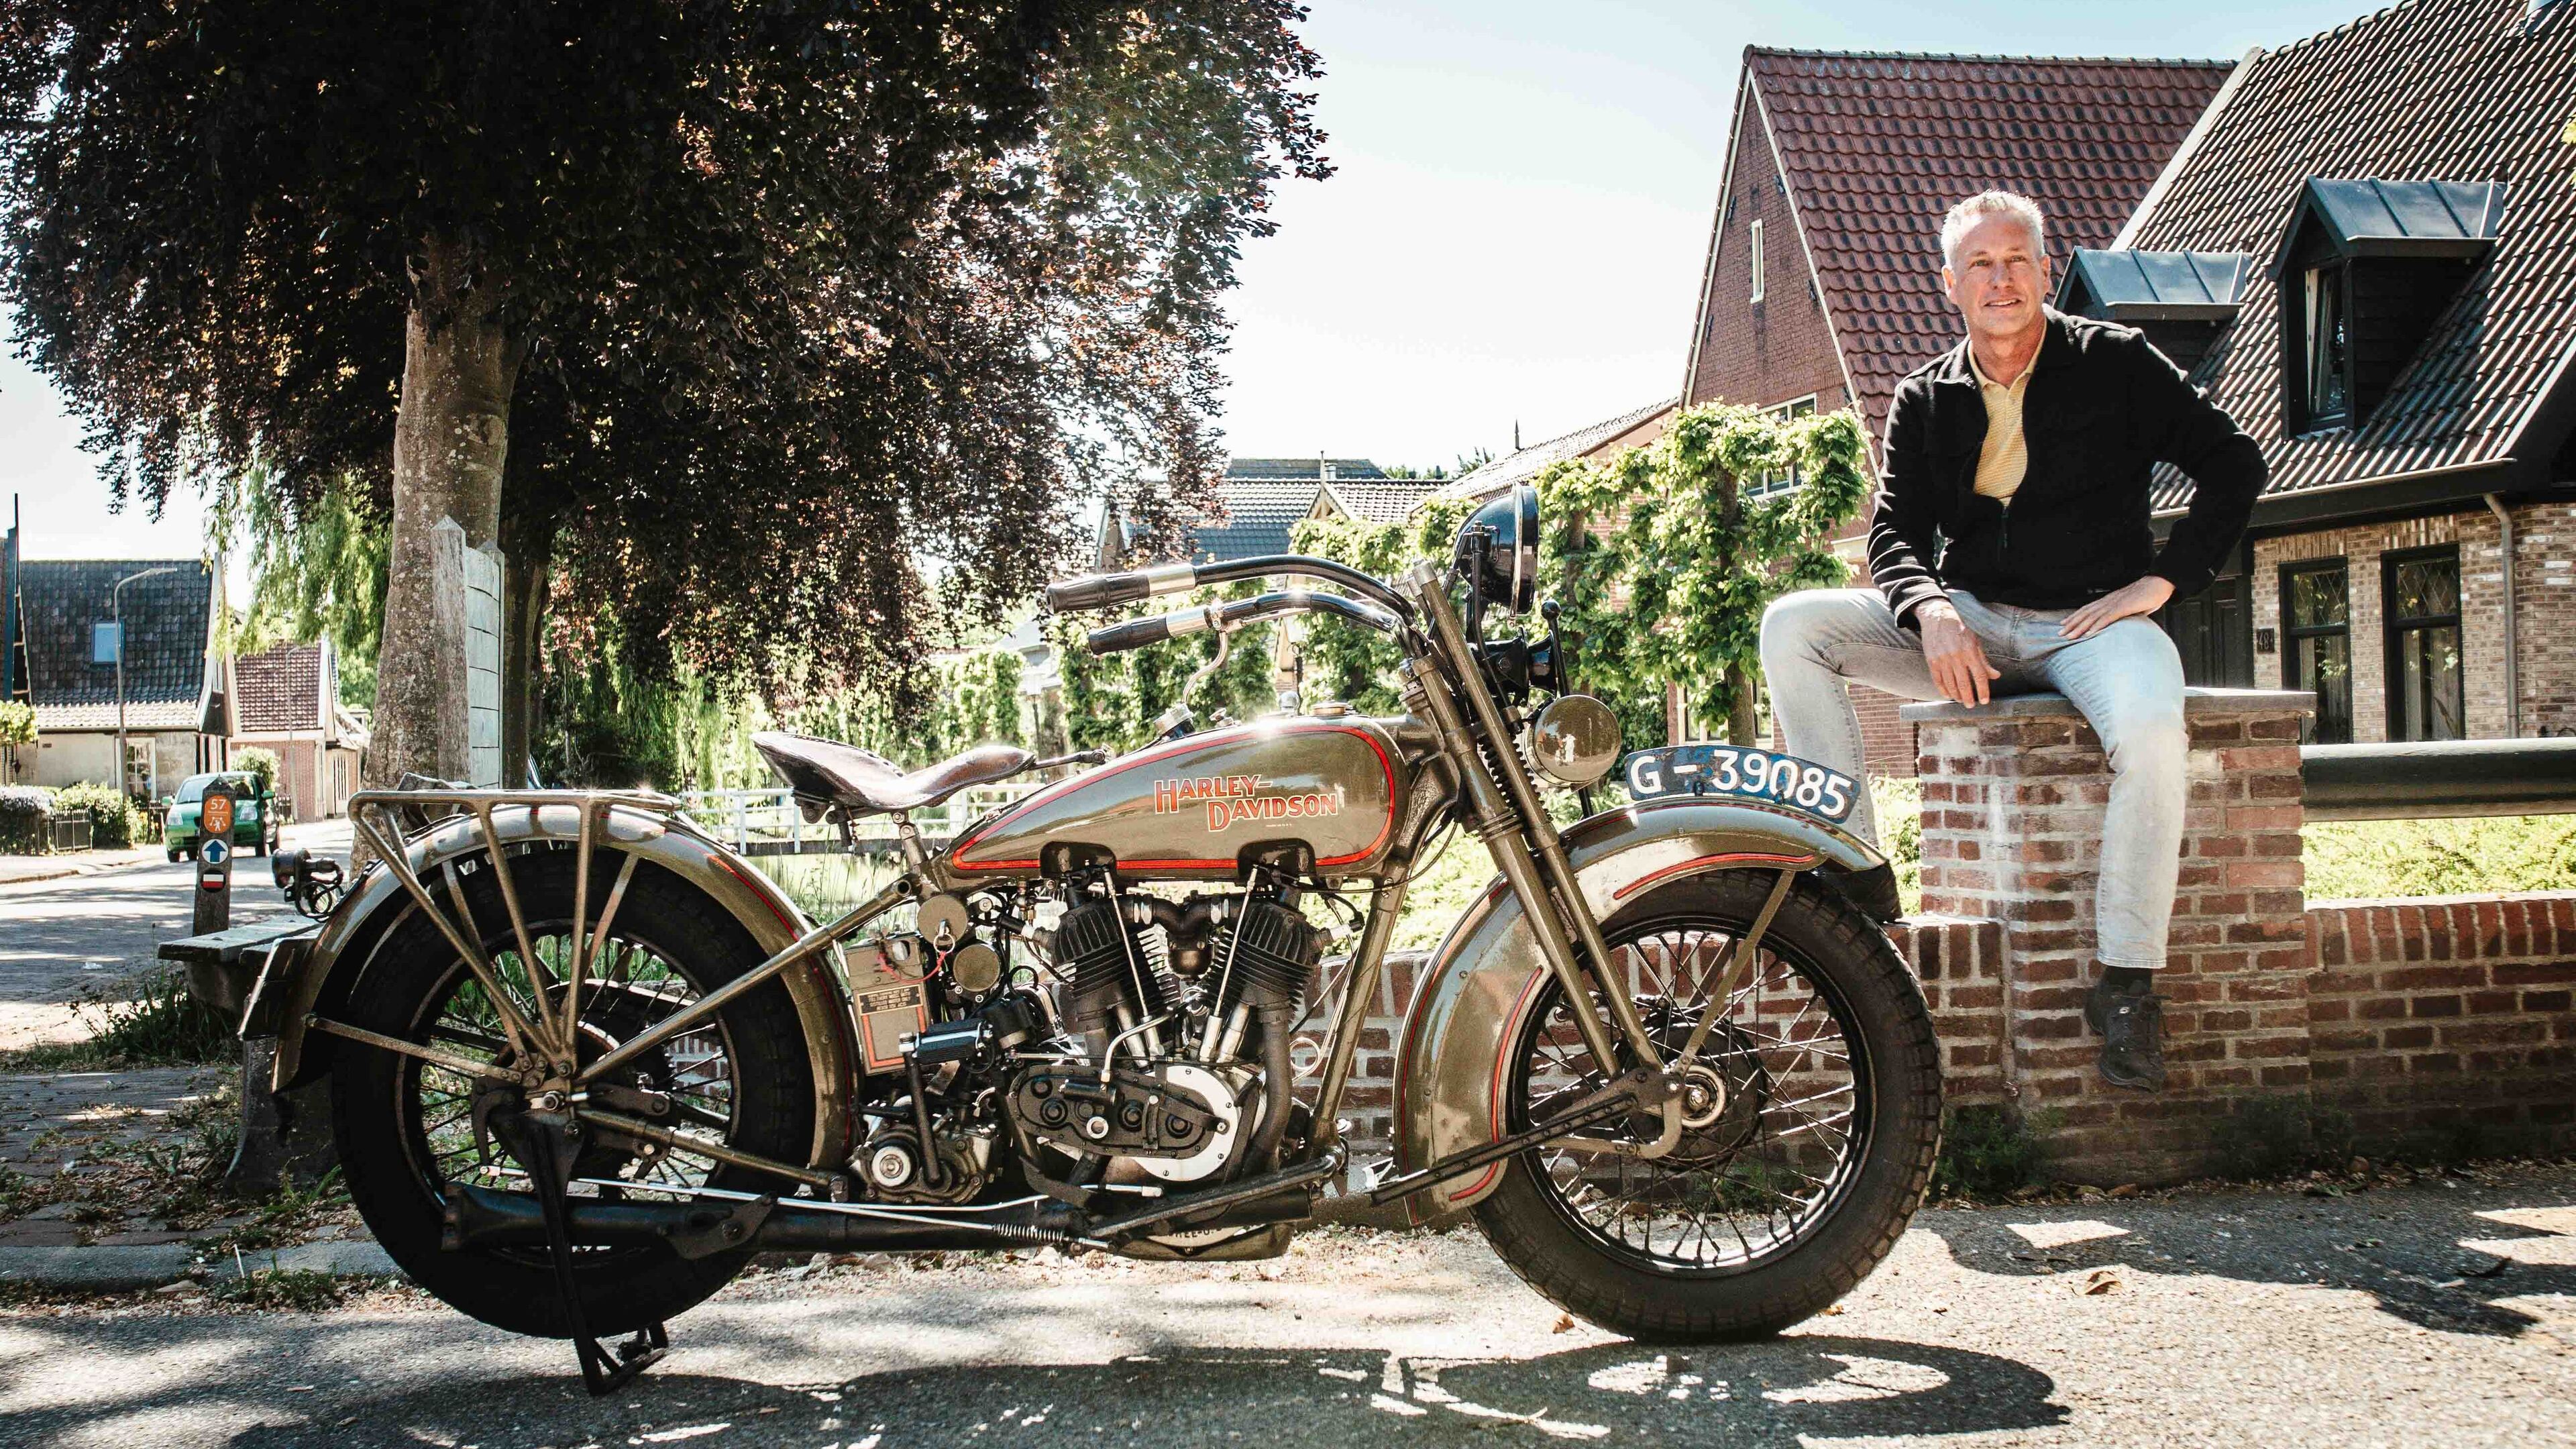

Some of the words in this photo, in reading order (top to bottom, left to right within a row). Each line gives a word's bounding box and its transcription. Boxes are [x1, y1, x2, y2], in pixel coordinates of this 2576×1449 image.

[2259, 632, 2269, 650] 48
[210, 798, 227, 810] 57
[1155, 774, 1273, 814] HARLEY-
[1207, 793, 1338, 833] DAVIDSON
